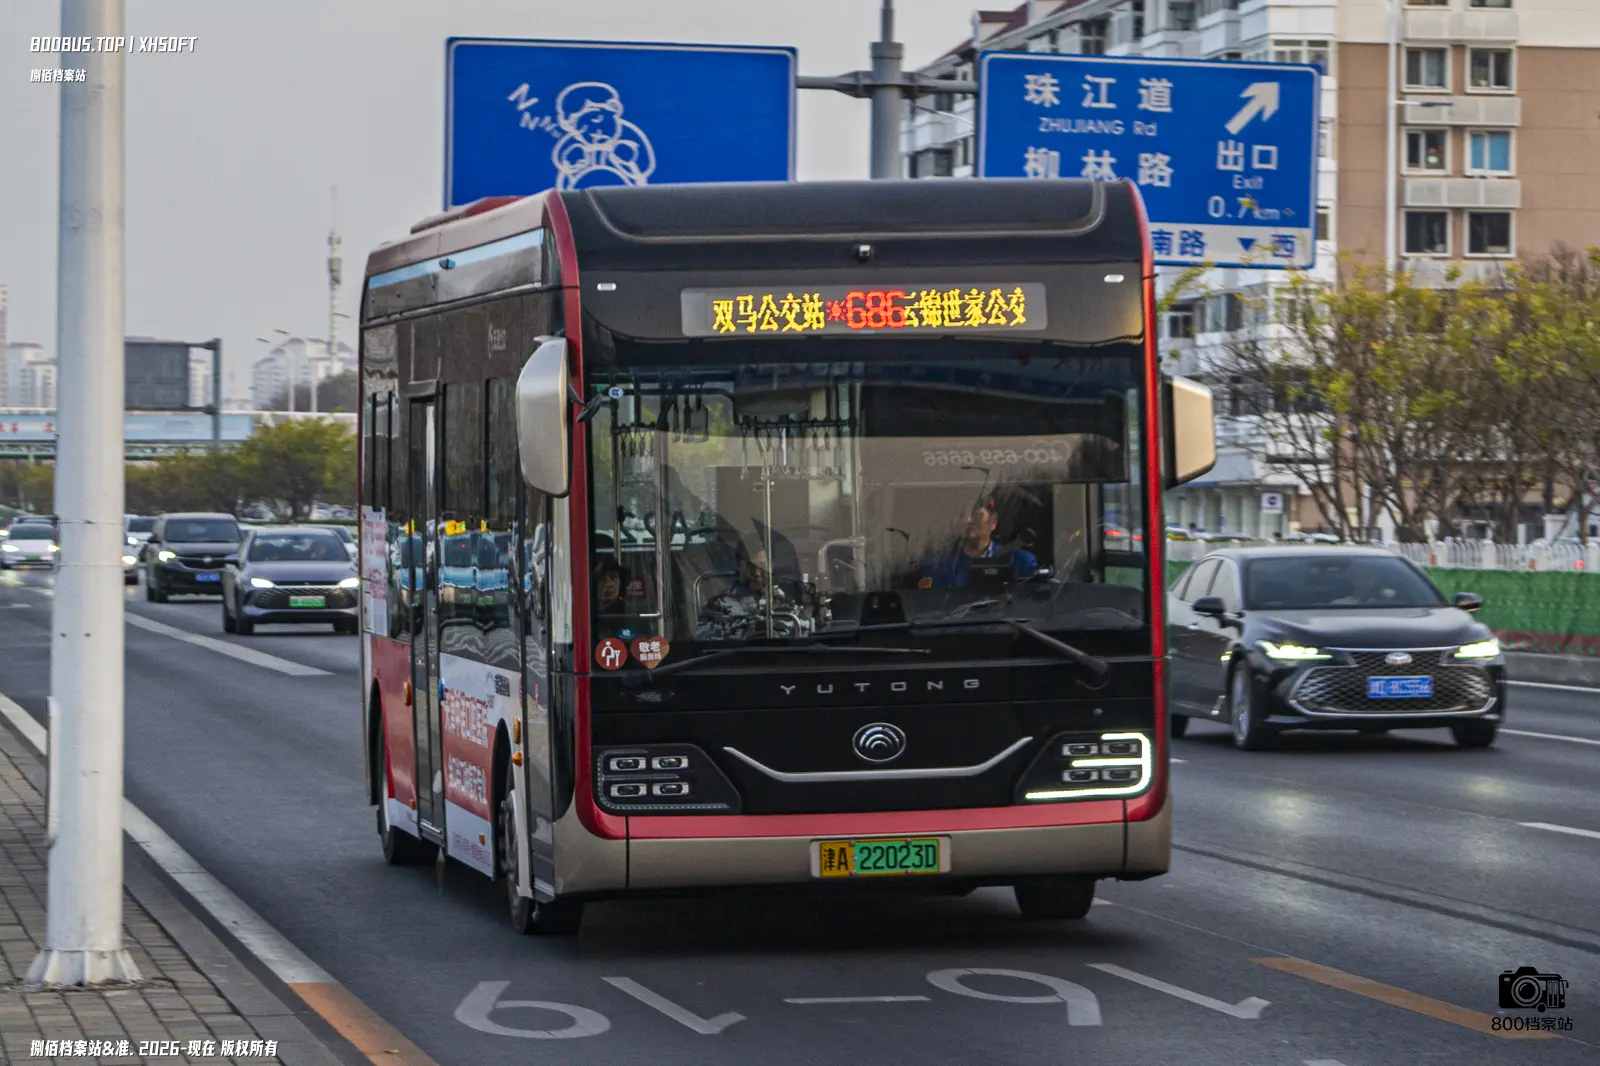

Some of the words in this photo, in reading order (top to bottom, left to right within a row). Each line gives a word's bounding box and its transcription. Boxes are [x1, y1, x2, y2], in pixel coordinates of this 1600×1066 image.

[1024, 72, 1173, 113] 珠江道
[1038, 116, 1124, 135] ZHUJIANG
[1133, 120, 1157, 136] Rd
[1023, 145, 1174, 188] 柳林路
[1216, 138, 1278, 172] 出口
[1232, 174, 1264, 190] Exit
[711, 292, 826, 334] 双马公交站
[844, 290, 907, 329] 686
[638, 641, 661, 653] 敬老
[780, 678, 981, 695] YUTONG
